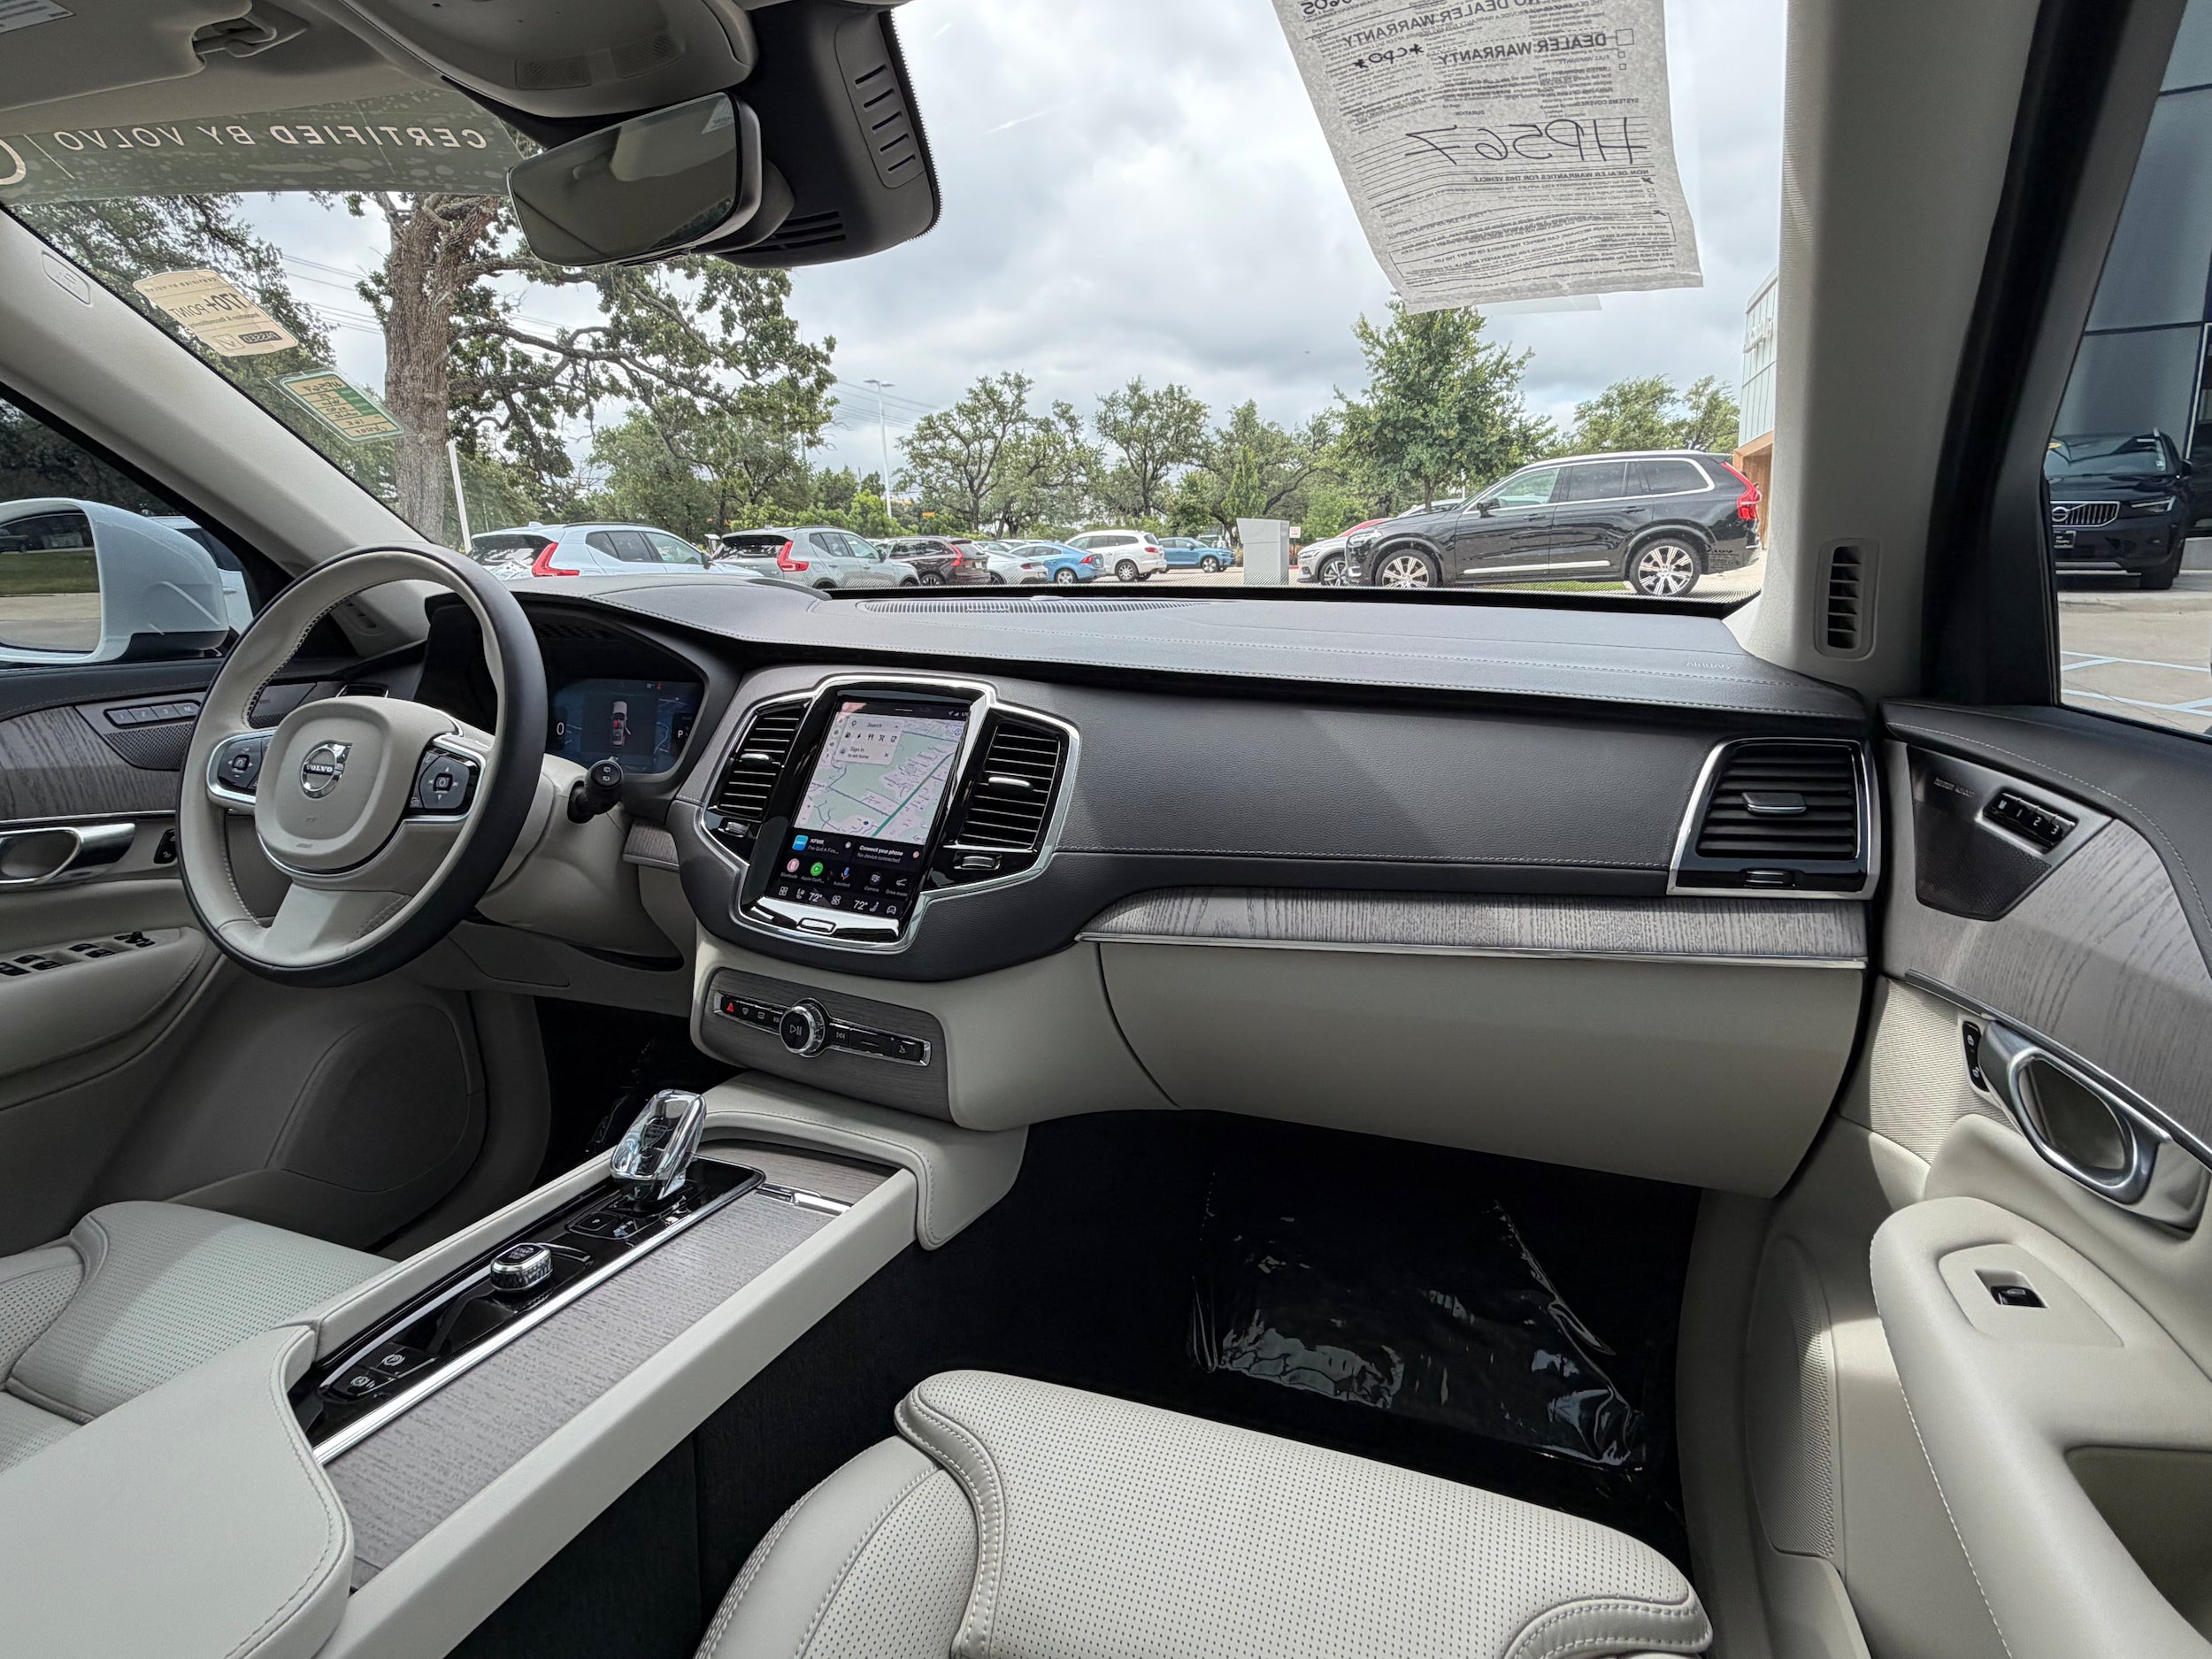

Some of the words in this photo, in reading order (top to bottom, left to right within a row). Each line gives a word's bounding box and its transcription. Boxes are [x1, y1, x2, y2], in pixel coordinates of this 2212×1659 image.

[677, 729, 684, 739] P
[306, 764, 334, 774] VOLVO
[808, 892, 823, 902] 72°
[853, 900, 869, 910] 72°
